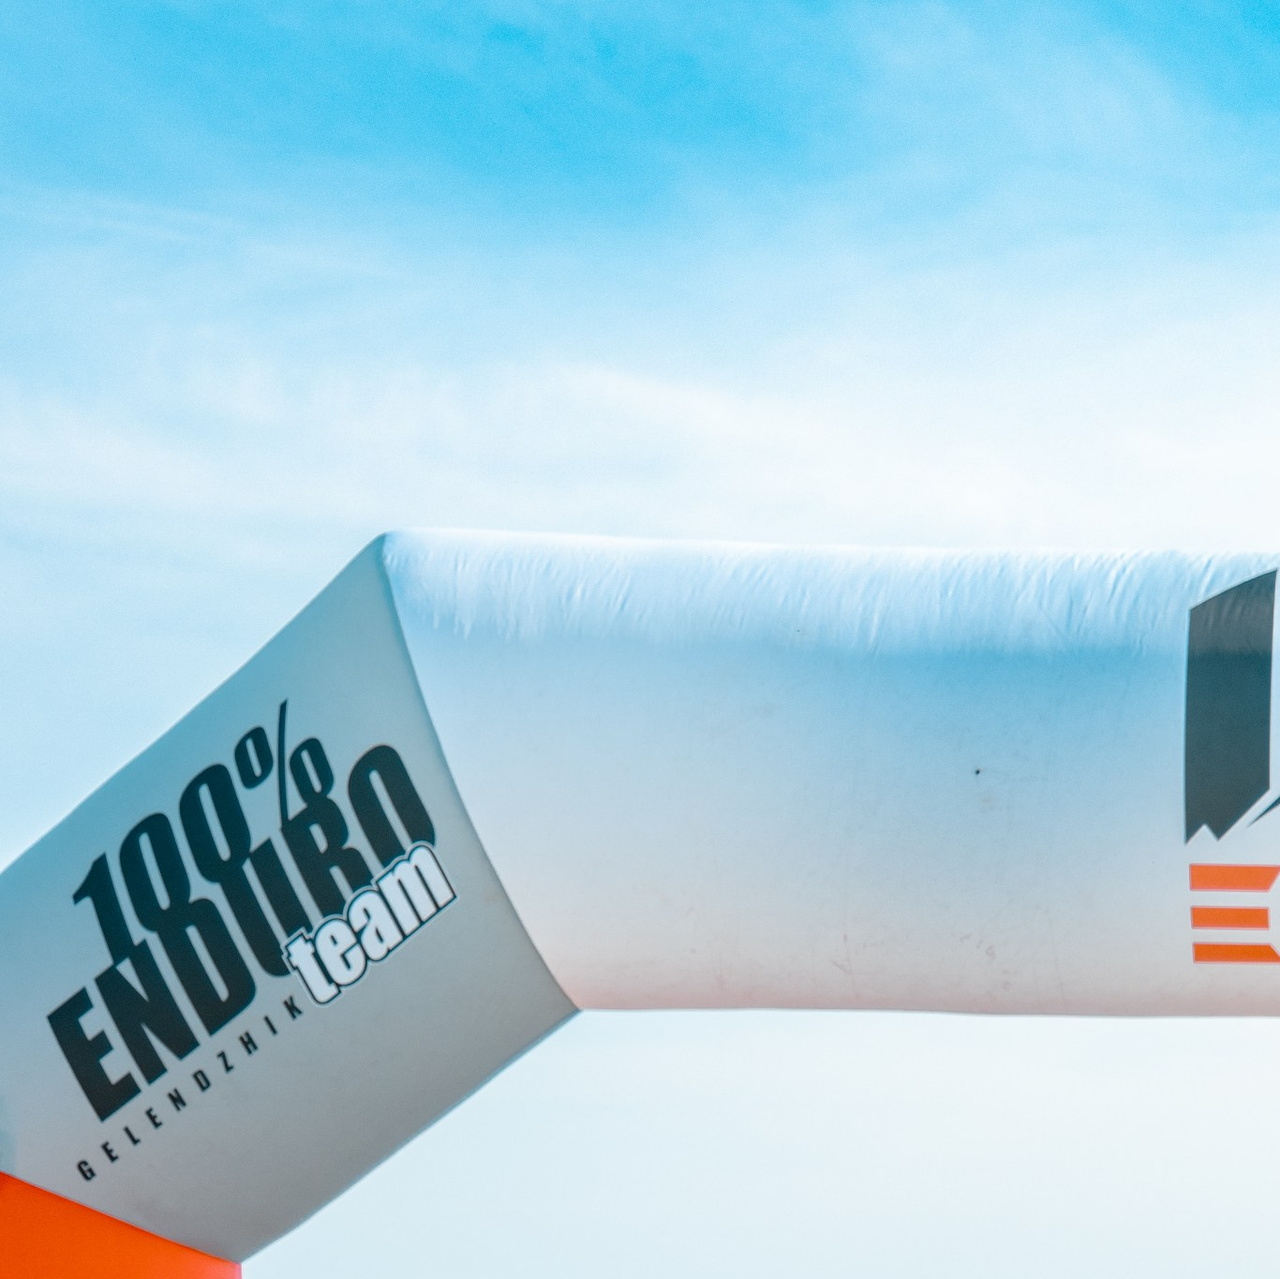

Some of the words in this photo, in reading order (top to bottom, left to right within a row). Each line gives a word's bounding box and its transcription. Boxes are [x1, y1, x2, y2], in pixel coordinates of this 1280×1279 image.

[46, 744, 437, 1123] ENDURO
[72, 698, 335, 966] 100%
[281, 841, 457, 1006] team
[76, 995, 305, 1182] GELENDZHIK
